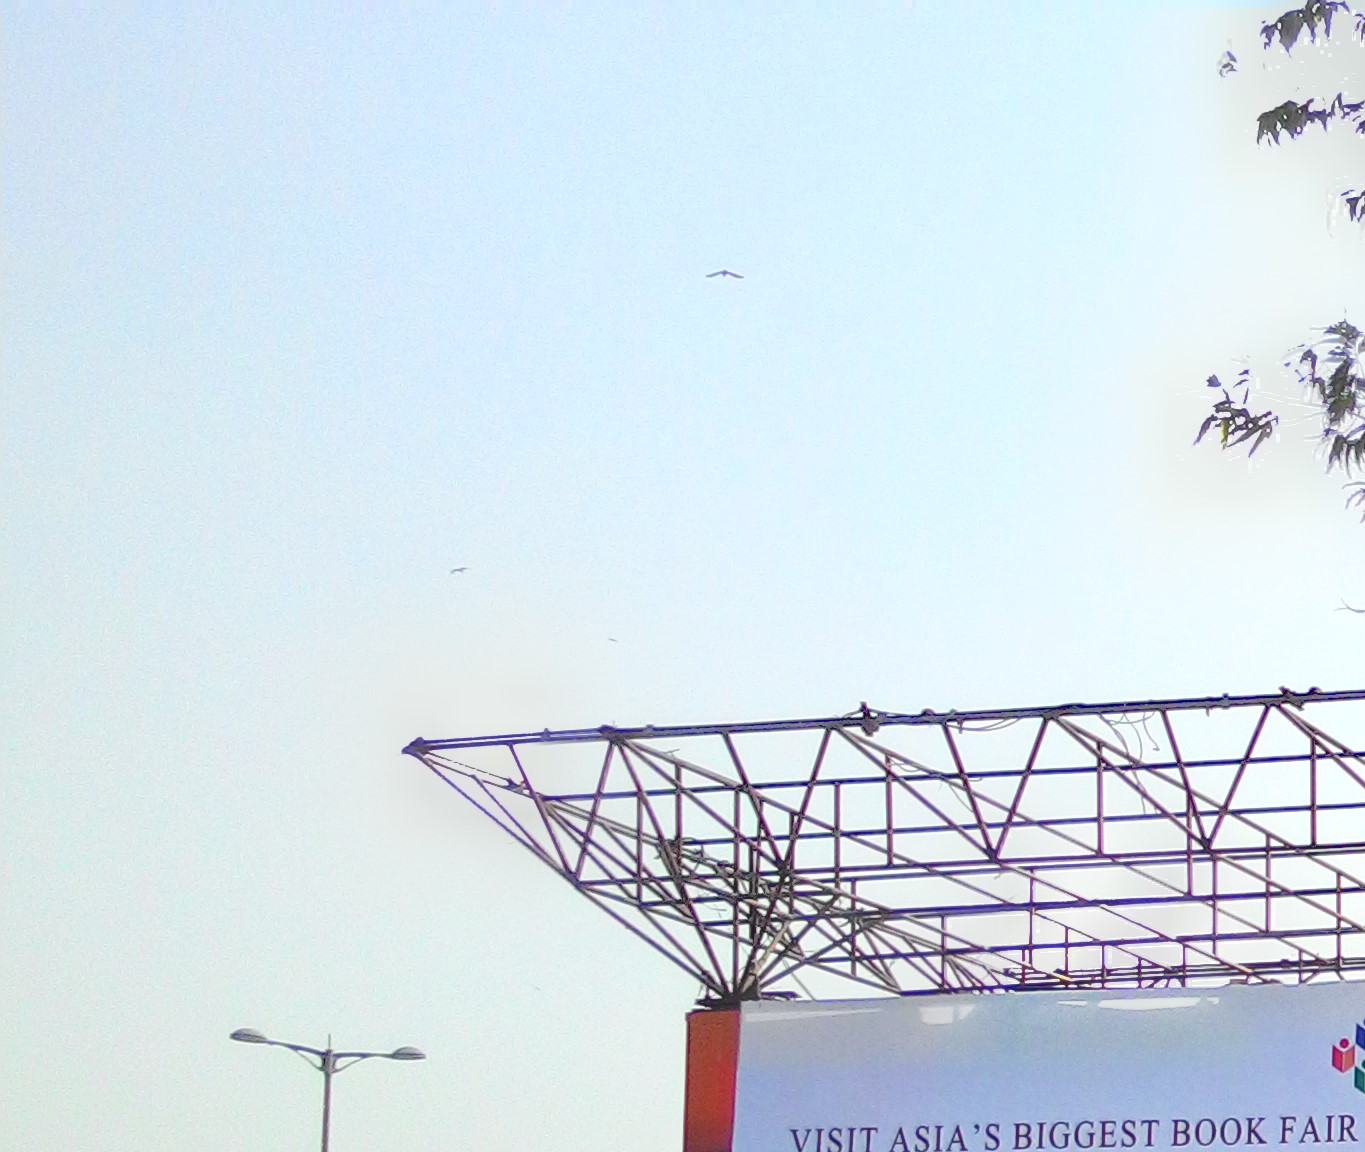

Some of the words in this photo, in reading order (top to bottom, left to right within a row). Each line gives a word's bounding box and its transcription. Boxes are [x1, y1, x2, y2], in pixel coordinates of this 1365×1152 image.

[888, 1122, 1001, 1152] ASIA'S
[1012, 1119, 1160, 1150] BIGGEST
[1171, 1117, 1267, 1147] BOOK
[1279, 1114, 1359, 1144] FAIR
